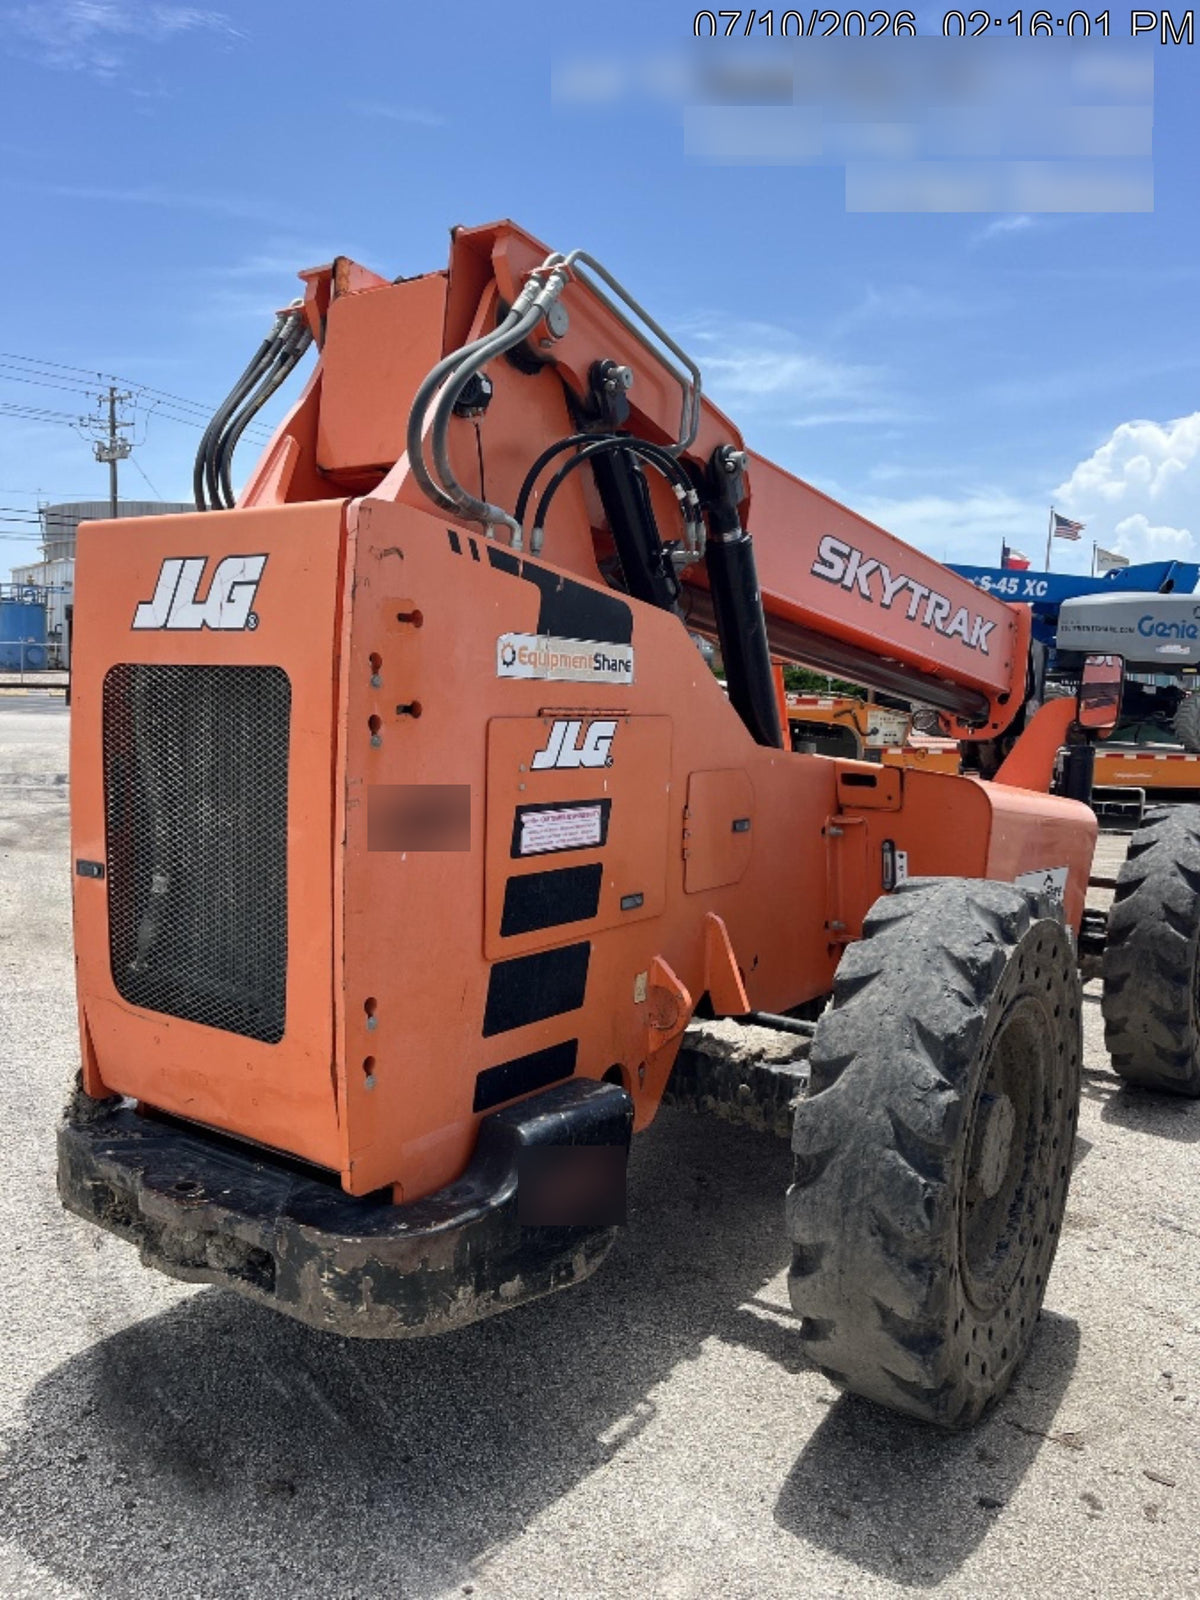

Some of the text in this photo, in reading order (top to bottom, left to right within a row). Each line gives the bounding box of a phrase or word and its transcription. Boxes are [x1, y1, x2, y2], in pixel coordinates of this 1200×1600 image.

[130, 553, 269, 631] JLG
[811, 534, 997, 655] SKYTRAK
[980, 575, 1020, 594] S-45
[1022, 579, 1048, 596] XC
[1138, 615, 1198, 639] Genie
[517, 645, 632, 673] EquipmentShare
[530, 719, 617, 771] JLG
